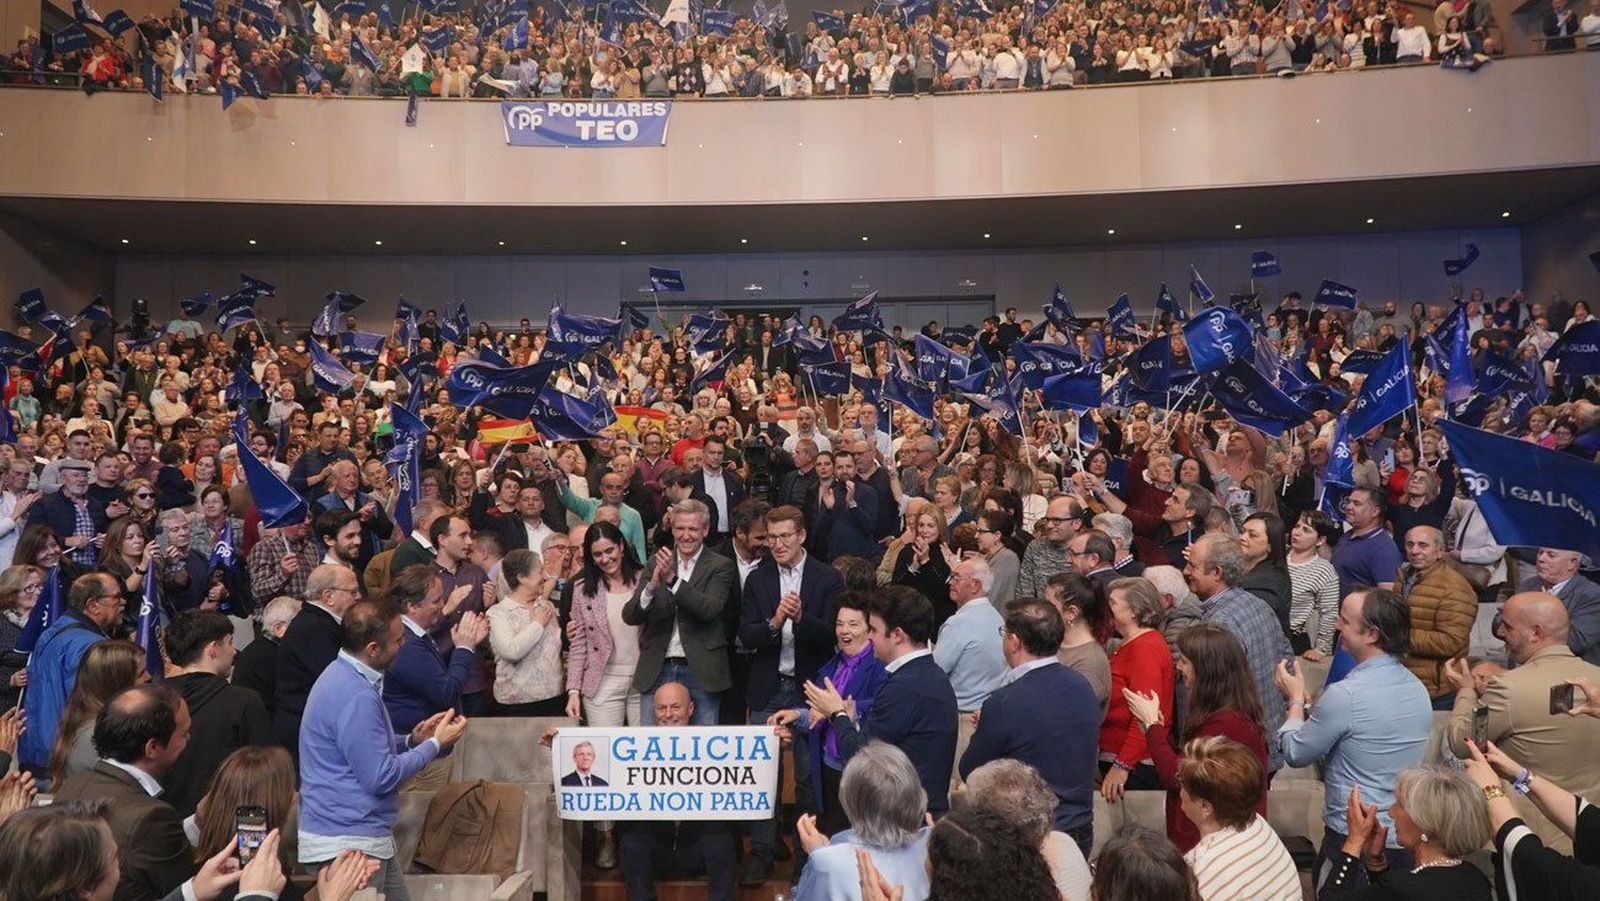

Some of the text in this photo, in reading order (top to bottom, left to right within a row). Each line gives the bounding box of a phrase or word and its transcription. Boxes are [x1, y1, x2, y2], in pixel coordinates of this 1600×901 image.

[548, 102, 667, 118] POPULARES
[576, 119, 639, 141] TEO
[1375, 364, 1410, 398] GALICIA
[1509, 485, 1597, 528] GALICIA
[611, 736, 772, 762] GALICIA
[626, 766, 758, 786] FUNCIONA
[561, 791, 771, 812] RUEDA NON PARA
